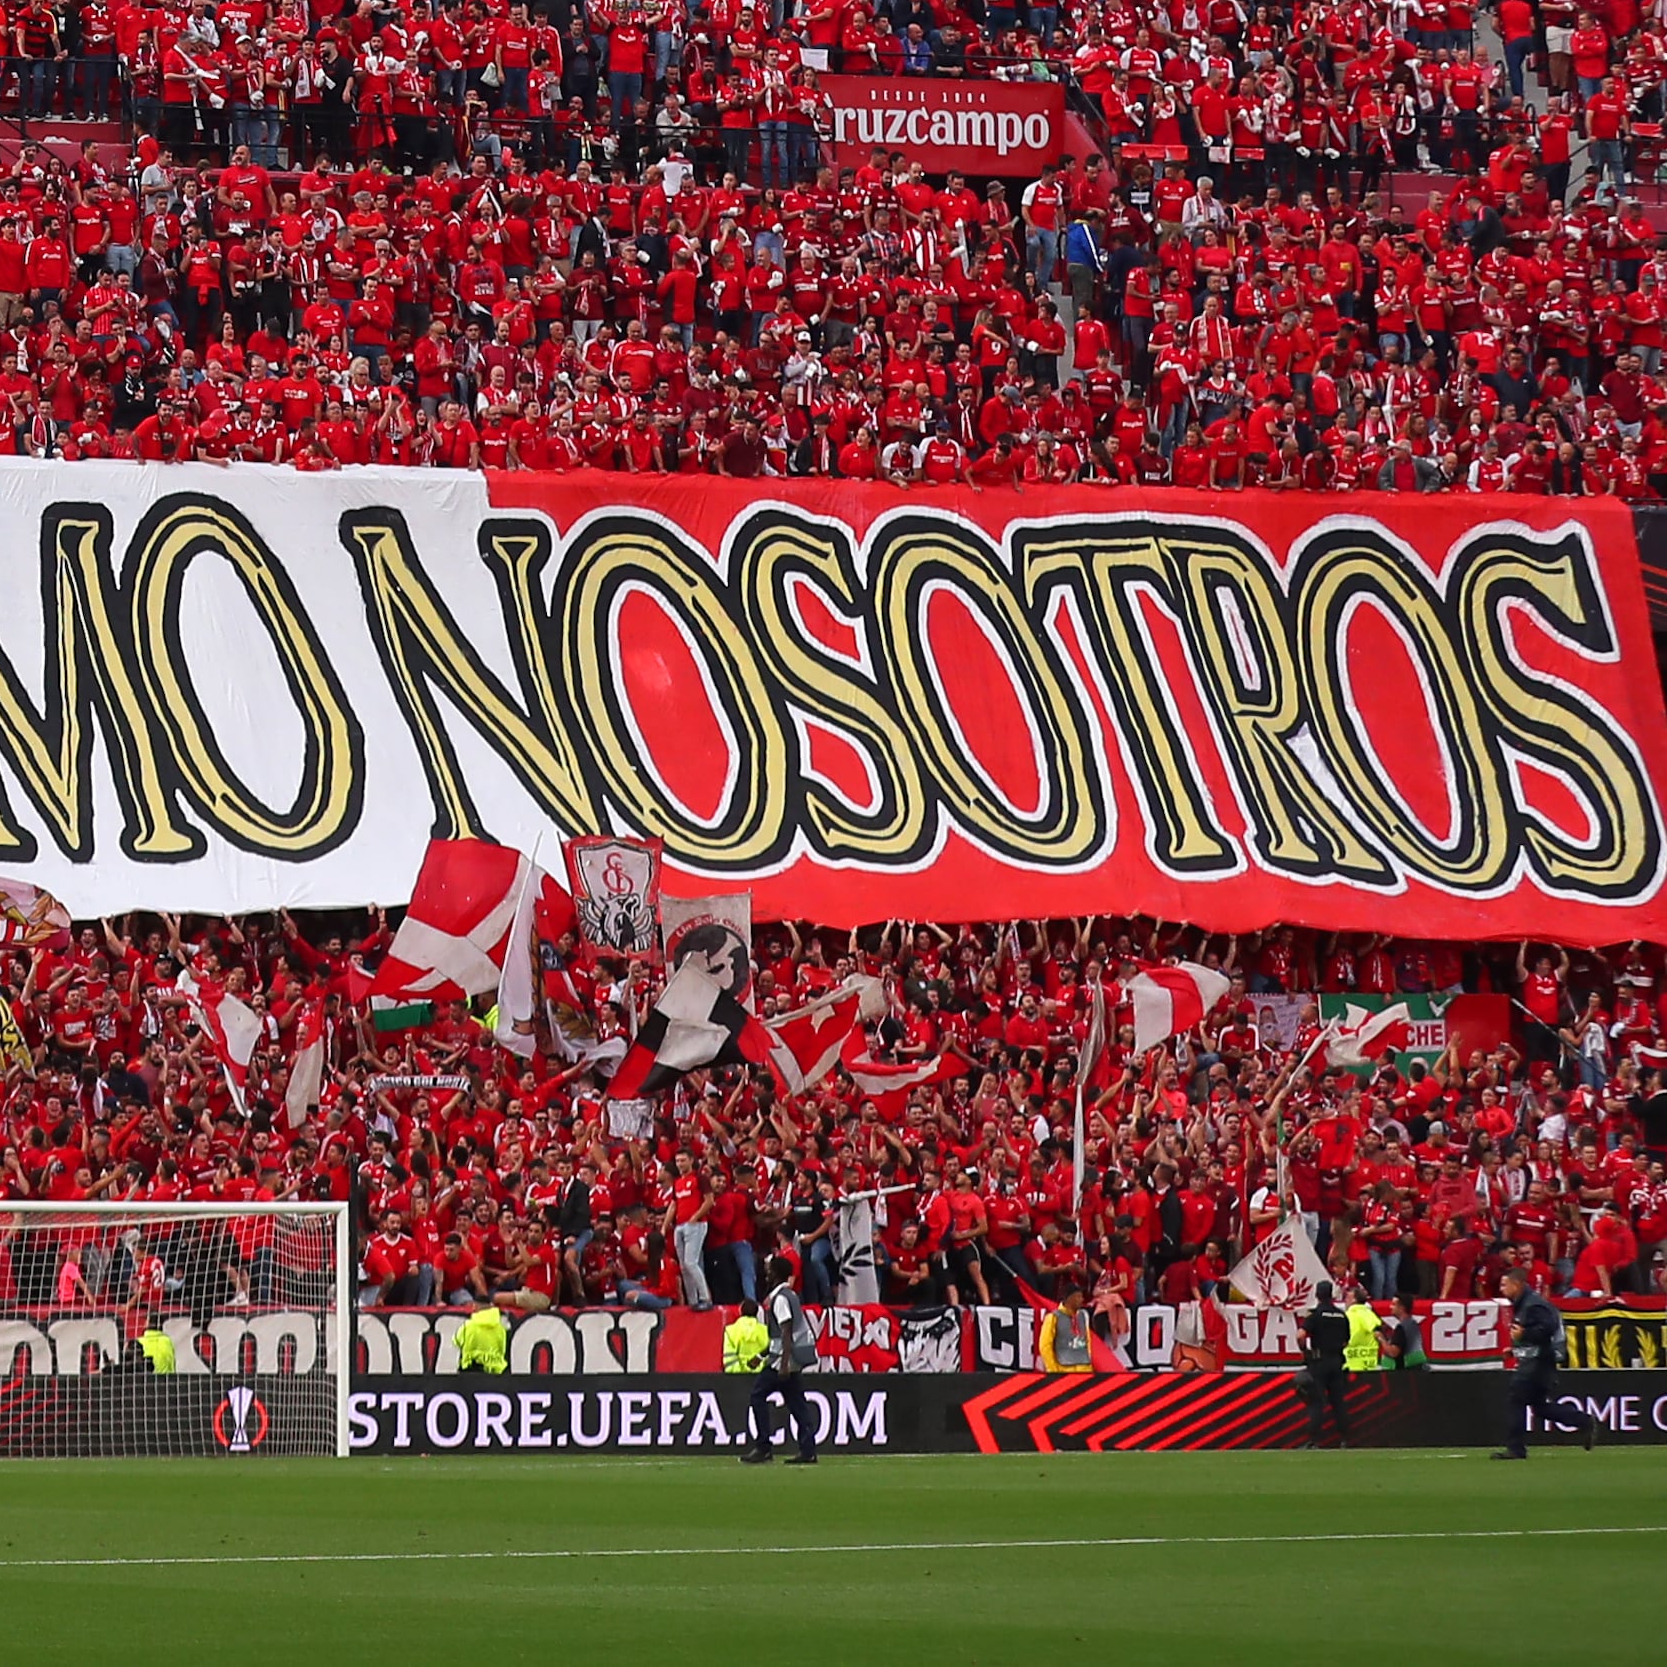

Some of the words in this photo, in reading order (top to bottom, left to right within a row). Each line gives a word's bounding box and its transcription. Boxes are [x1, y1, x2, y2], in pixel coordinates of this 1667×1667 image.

[337, 500, 1665, 906] NOSOTROS
[1431, 1300, 1499, 1352] 22
[348, 1391, 889, 1448] STORE.UEFA.COM
